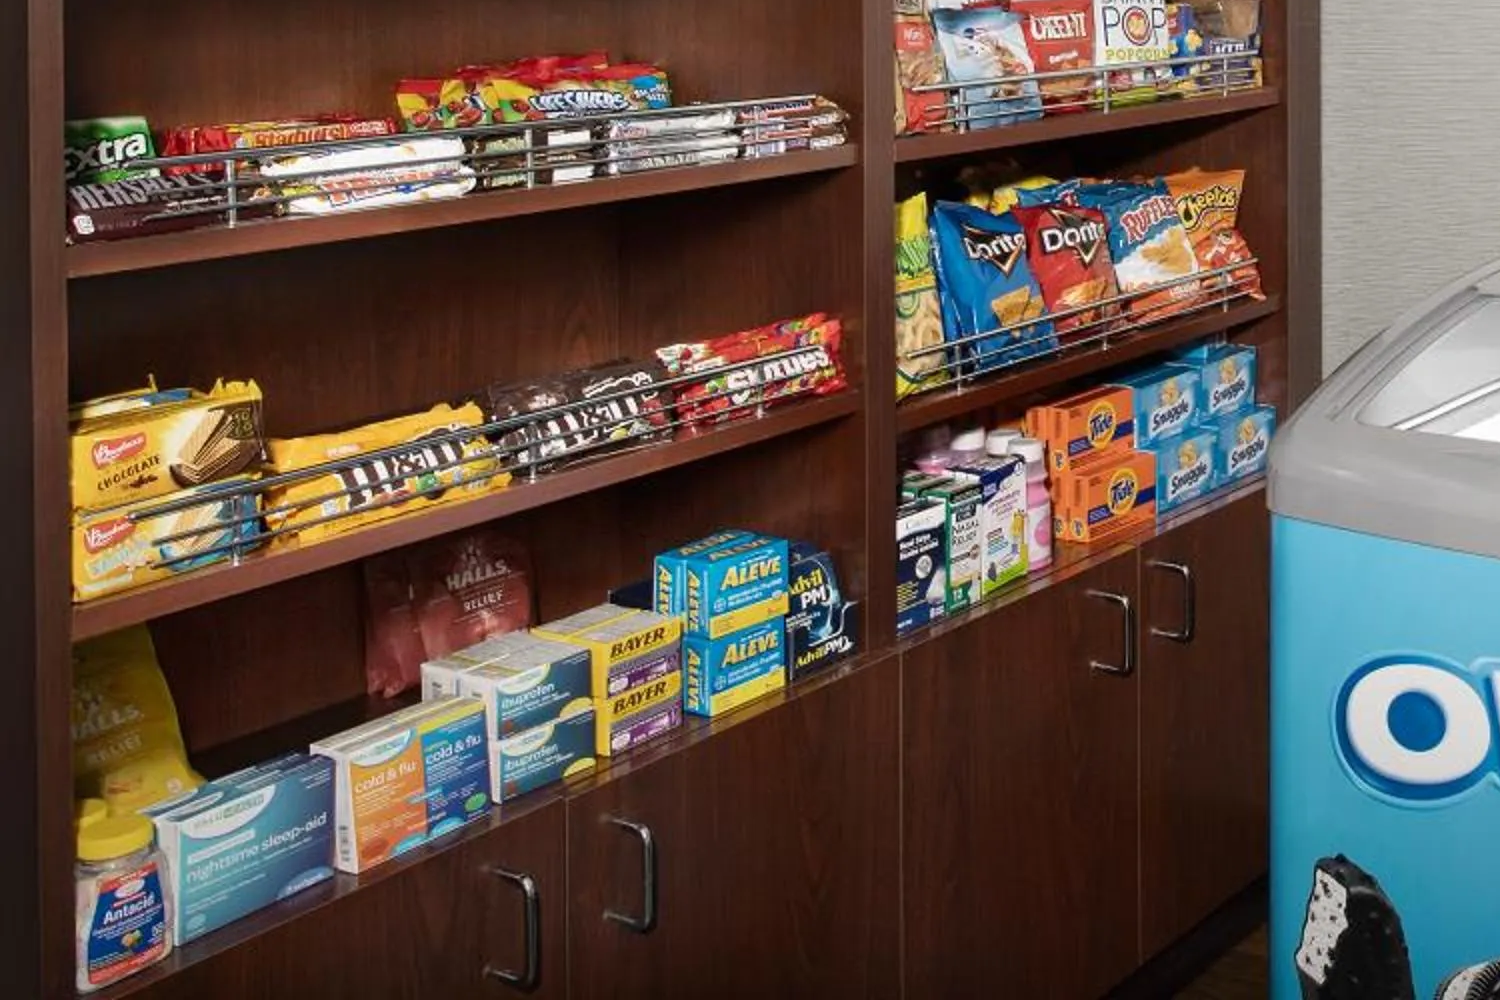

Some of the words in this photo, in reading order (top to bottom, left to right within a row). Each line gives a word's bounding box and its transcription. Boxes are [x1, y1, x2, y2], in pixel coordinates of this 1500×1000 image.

[1101, 5, 1167, 47] POP
[1089, 411, 1114, 438] Tide
[1152, 399, 1191, 430] Snuggle
[97, 454, 161, 491] CHOCOLATE
[1170, 462, 1209, 494] Snuggle
[1110, 478, 1136, 505] Tide
[446, 558, 508, 591] HALLS
[721, 557, 781, 592] ALEVE
[463, 589, 504, 613] RELIEF
[801, 586, 826, 609] PM
[610, 626, 666, 659] BAYER
[721, 630, 779, 668] ALEVE
[612, 680, 668, 715] BAYER
[425, 743, 453, 765] cold
[465, 733, 482, 749] flu
[354, 771, 385, 794] cold
[399, 760, 417, 782] flu
[261, 811, 328, 852] sleep-aid
[104, 894, 155, 926] Antacid
